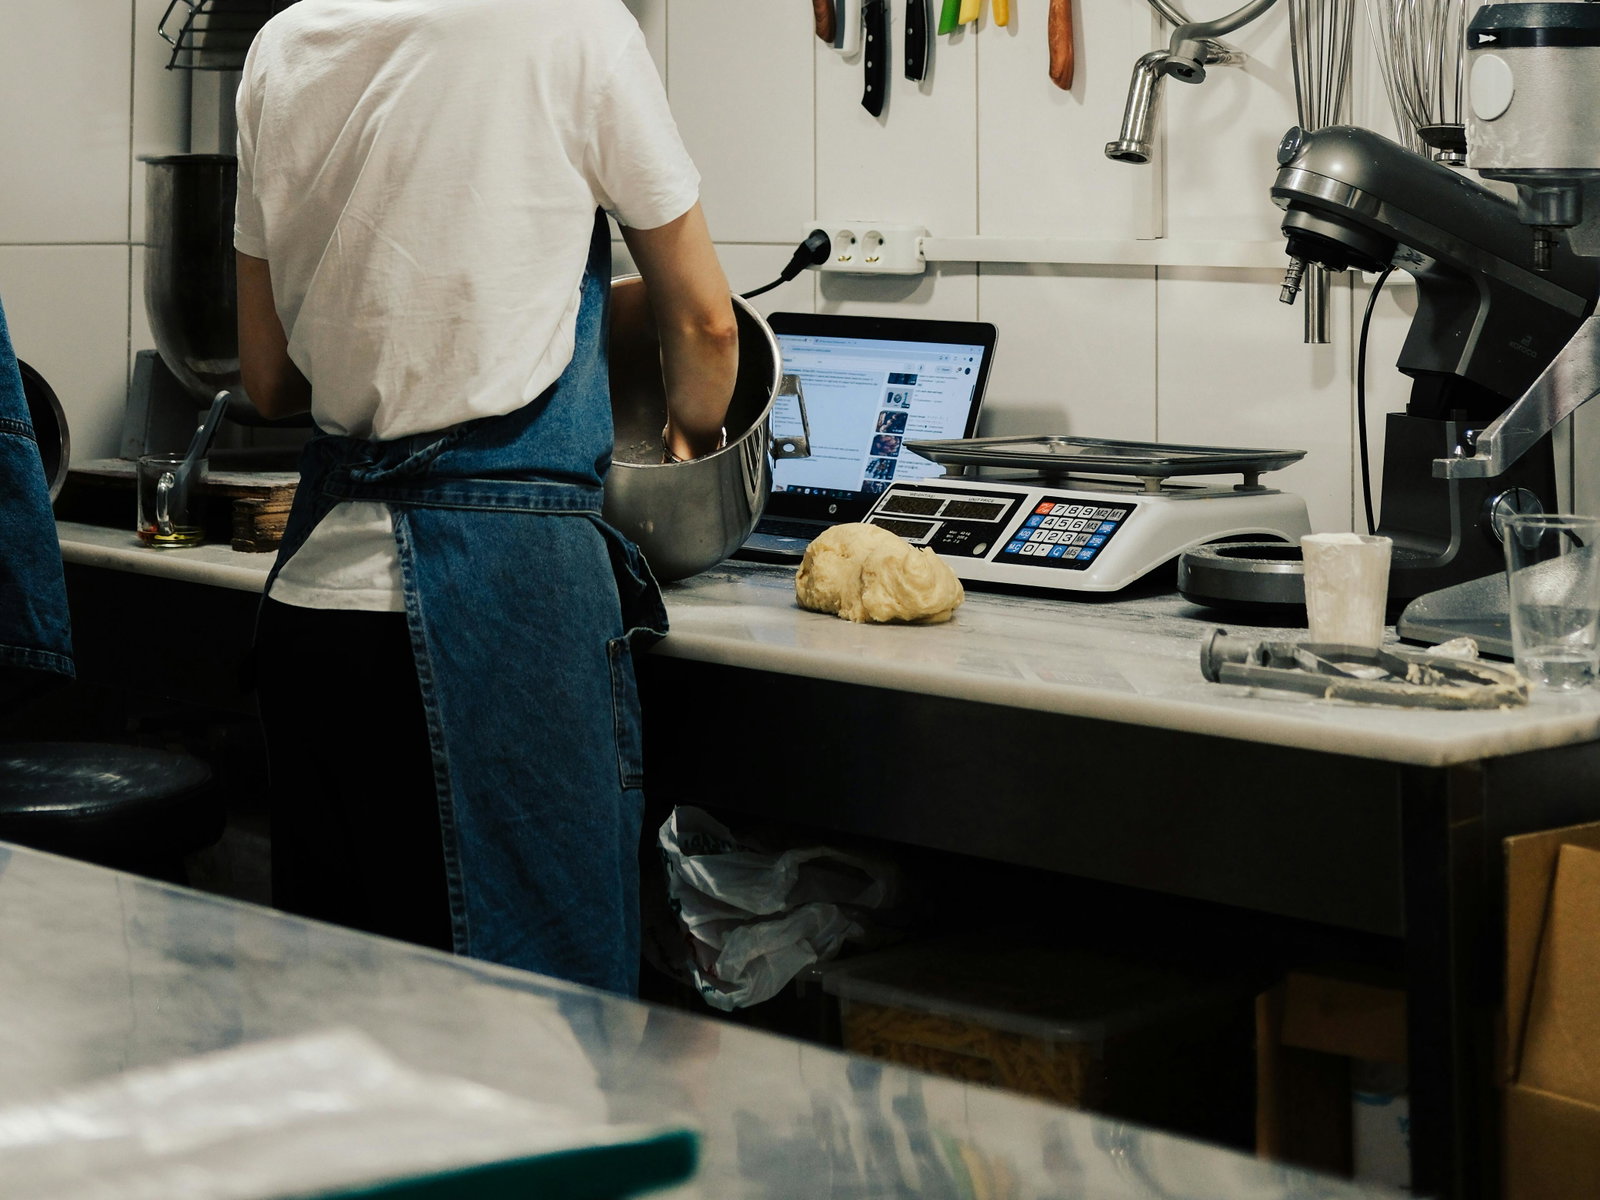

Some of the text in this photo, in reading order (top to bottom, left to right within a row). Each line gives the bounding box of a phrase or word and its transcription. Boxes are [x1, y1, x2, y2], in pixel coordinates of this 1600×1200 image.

[1054, 505, 1066, 513] 7
[1068, 506, 1079, 514] 8
[1082, 507, 1094, 516] 9
[1096, 509, 1109, 518] M2
[1110, 510, 1123, 519] M1
[1044, 518, 1055, 526] 4
[1058, 519, 1070, 527] 5
[1072, 521, 1083, 529] 6
[1036, 531, 1043, 539] 1
[1048, 532, 1059, 541] 2
[1062, 534, 1073, 542] 3
[1023, 544, 1035, 553] 0
[1053, 547, 1063, 556] C
